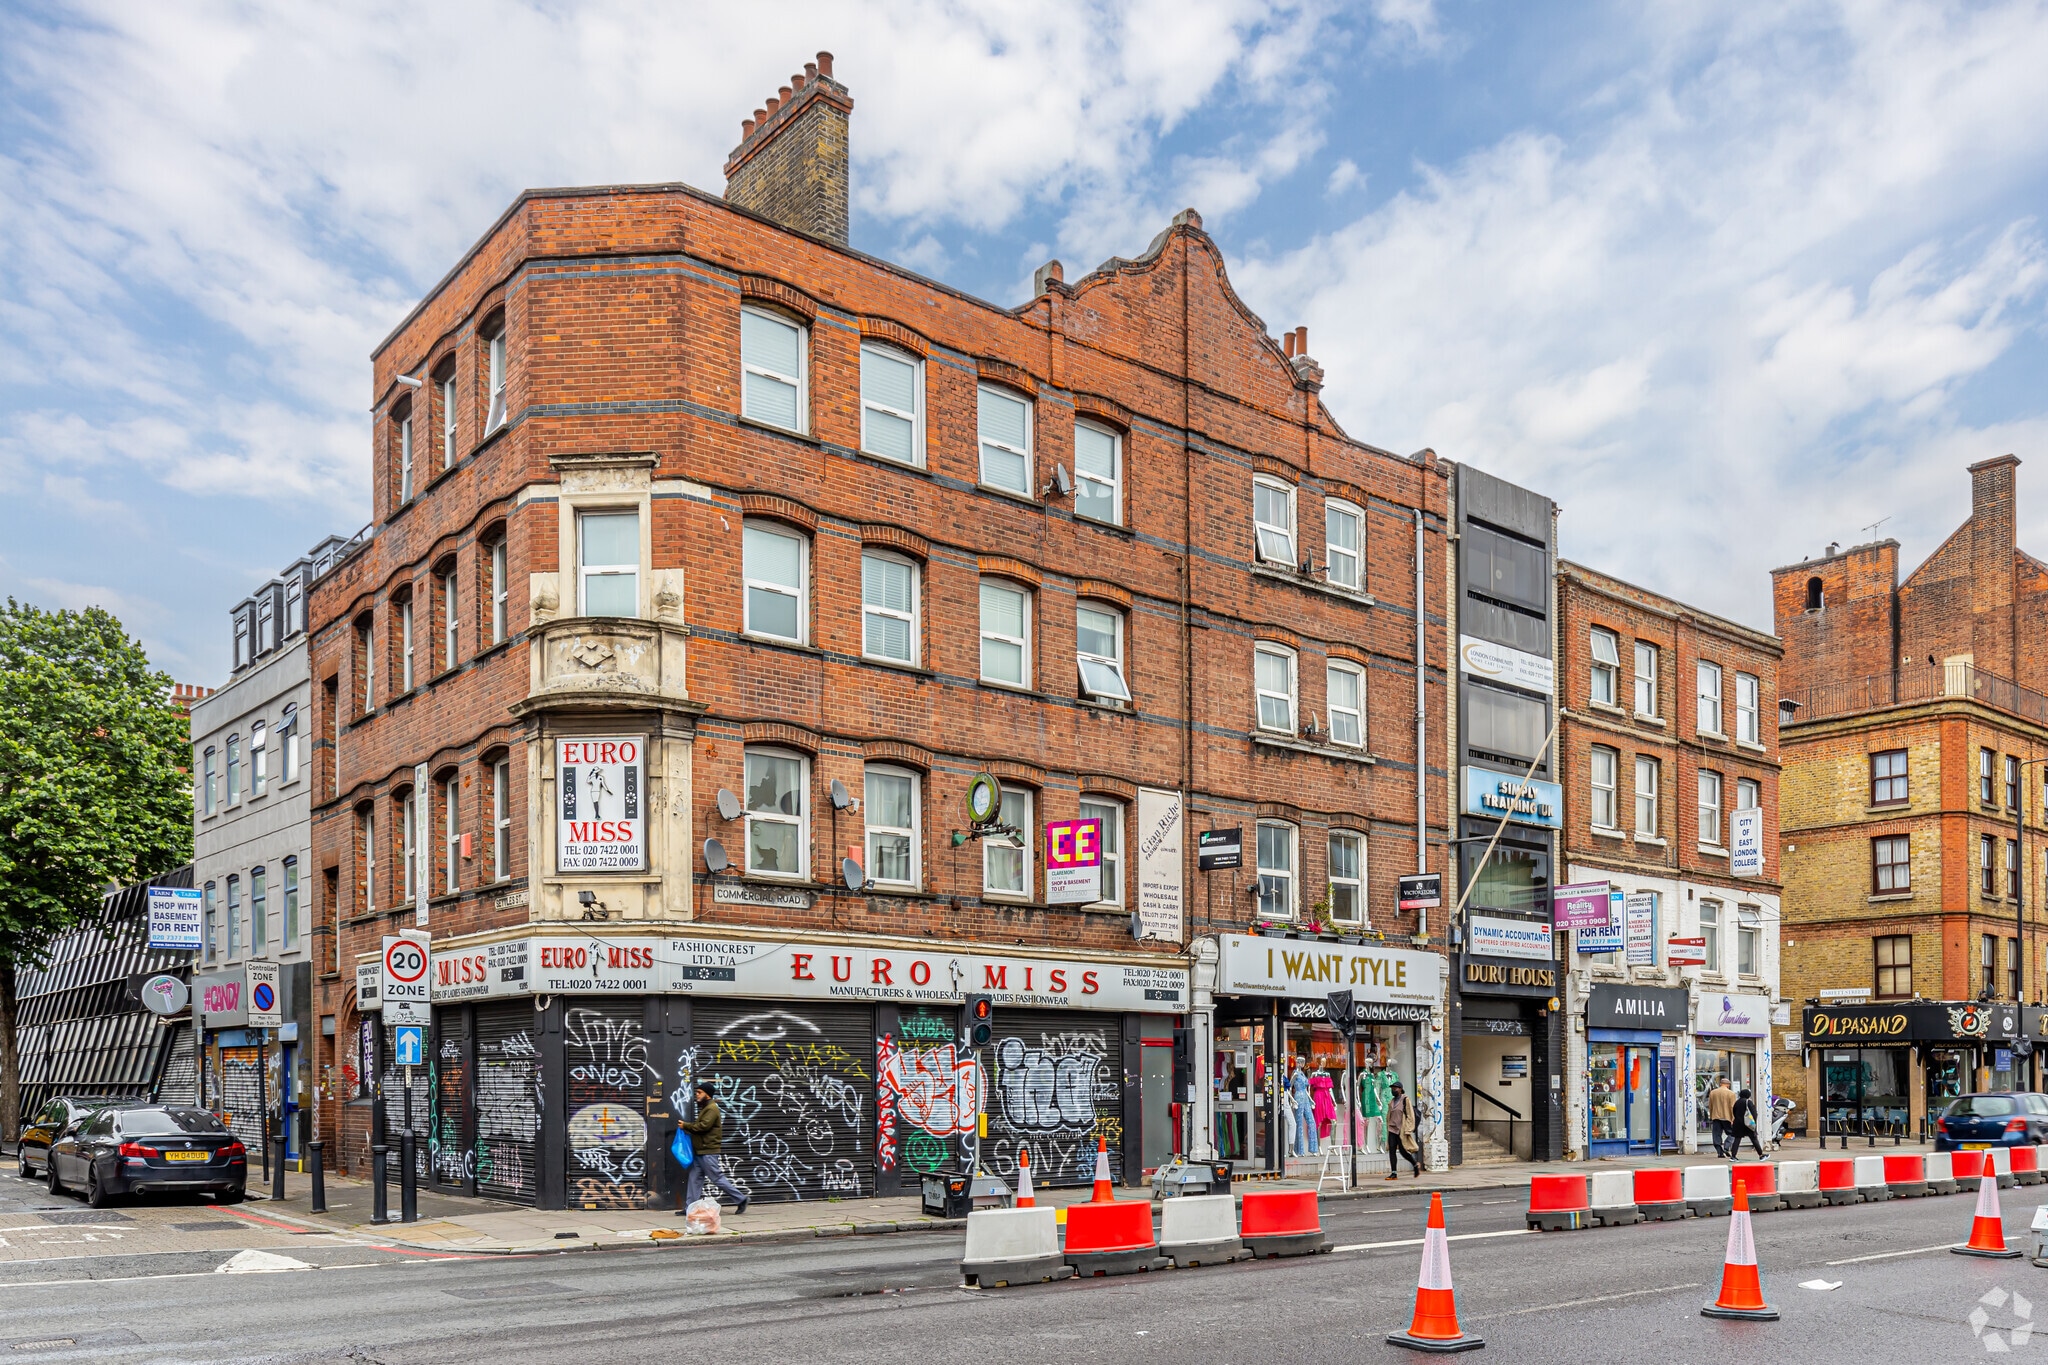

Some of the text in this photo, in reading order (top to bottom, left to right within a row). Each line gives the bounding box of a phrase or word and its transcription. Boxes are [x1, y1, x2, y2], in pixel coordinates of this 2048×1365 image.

[563, 741, 637, 764] EURO
[1499, 781, 1539, 799] SIMPLY
[1482, 793, 1555, 817] TRAINING UK
[1739, 819, 1753, 827] CITY
[568, 821, 634, 843] MISS
[1742, 828, 1750, 836] OF
[1738, 838, 1753, 847] EAST
[564, 845, 639, 855] TEL: 020 7422 0001
[1734, 848, 1758, 857] LONDON
[563, 857, 639, 867] FAX: 020 7422 0009
[1734, 858, 1758, 867] COLLEGE
[717, 889, 801, 904] COMMERCIAL ROAD
[1143, 892, 1178, 901] WHOLESALE
[153, 902, 175, 910] SHOP
[154, 912, 198, 921] BASEMENT
[151, 923, 200, 932] FOR RENT
[1580, 926, 1621, 937] FOR RENT
[1473, 926, 1551, 943] DYNAMIC ACCOUNTANTS
[497, 945, 506, 955] 020
[505, 943, 516, 954] 7422
[516, 942, 528, 952] 0001
[672, 941, 756, 955] FASHIONCREST
[1232, 940, 1240, 948] 97
[1474, 938, 1551, 950] CHARTERED CERTIFIED ACCOUNTANTS
[393, 952, 421, 970] 20
[497, 953, 528, 967] 020 7422 0009
[540, 947, 654, 969] EURO MISS
[693, 955, 736, 966] LTD. T/A
[248, 963, 278, 972] Controlled
[438, 955, 486, 986] MISS
[791, 953, 1099, 994] EURO MISS
[1267, 948, 1407, 988] I WANT STYLE
[252, 973, 273, 981] ZONE
[1152, 970, 1185, 980] 7422 0001
[1466, 963, 1556, 987] DURU HOUSE
[388, 984, 425, 996] ZONE
[595, 979, 647, 989] 7422 0001
[1152, 980, 1185, 990] 7422 0009
[204, 981, 241, 1013] #CANDY
[447, 987, 461, 998] LADIES
[461, 985, 489, 997] FASHIONWEAR
[830, 985, 1069, 1005] MANUFACTURERS & FASHIONWEAR
[1614, 998, 1666, 1017] AMILIA
[1809, 1013, 1908, 1037] DILPASAND
